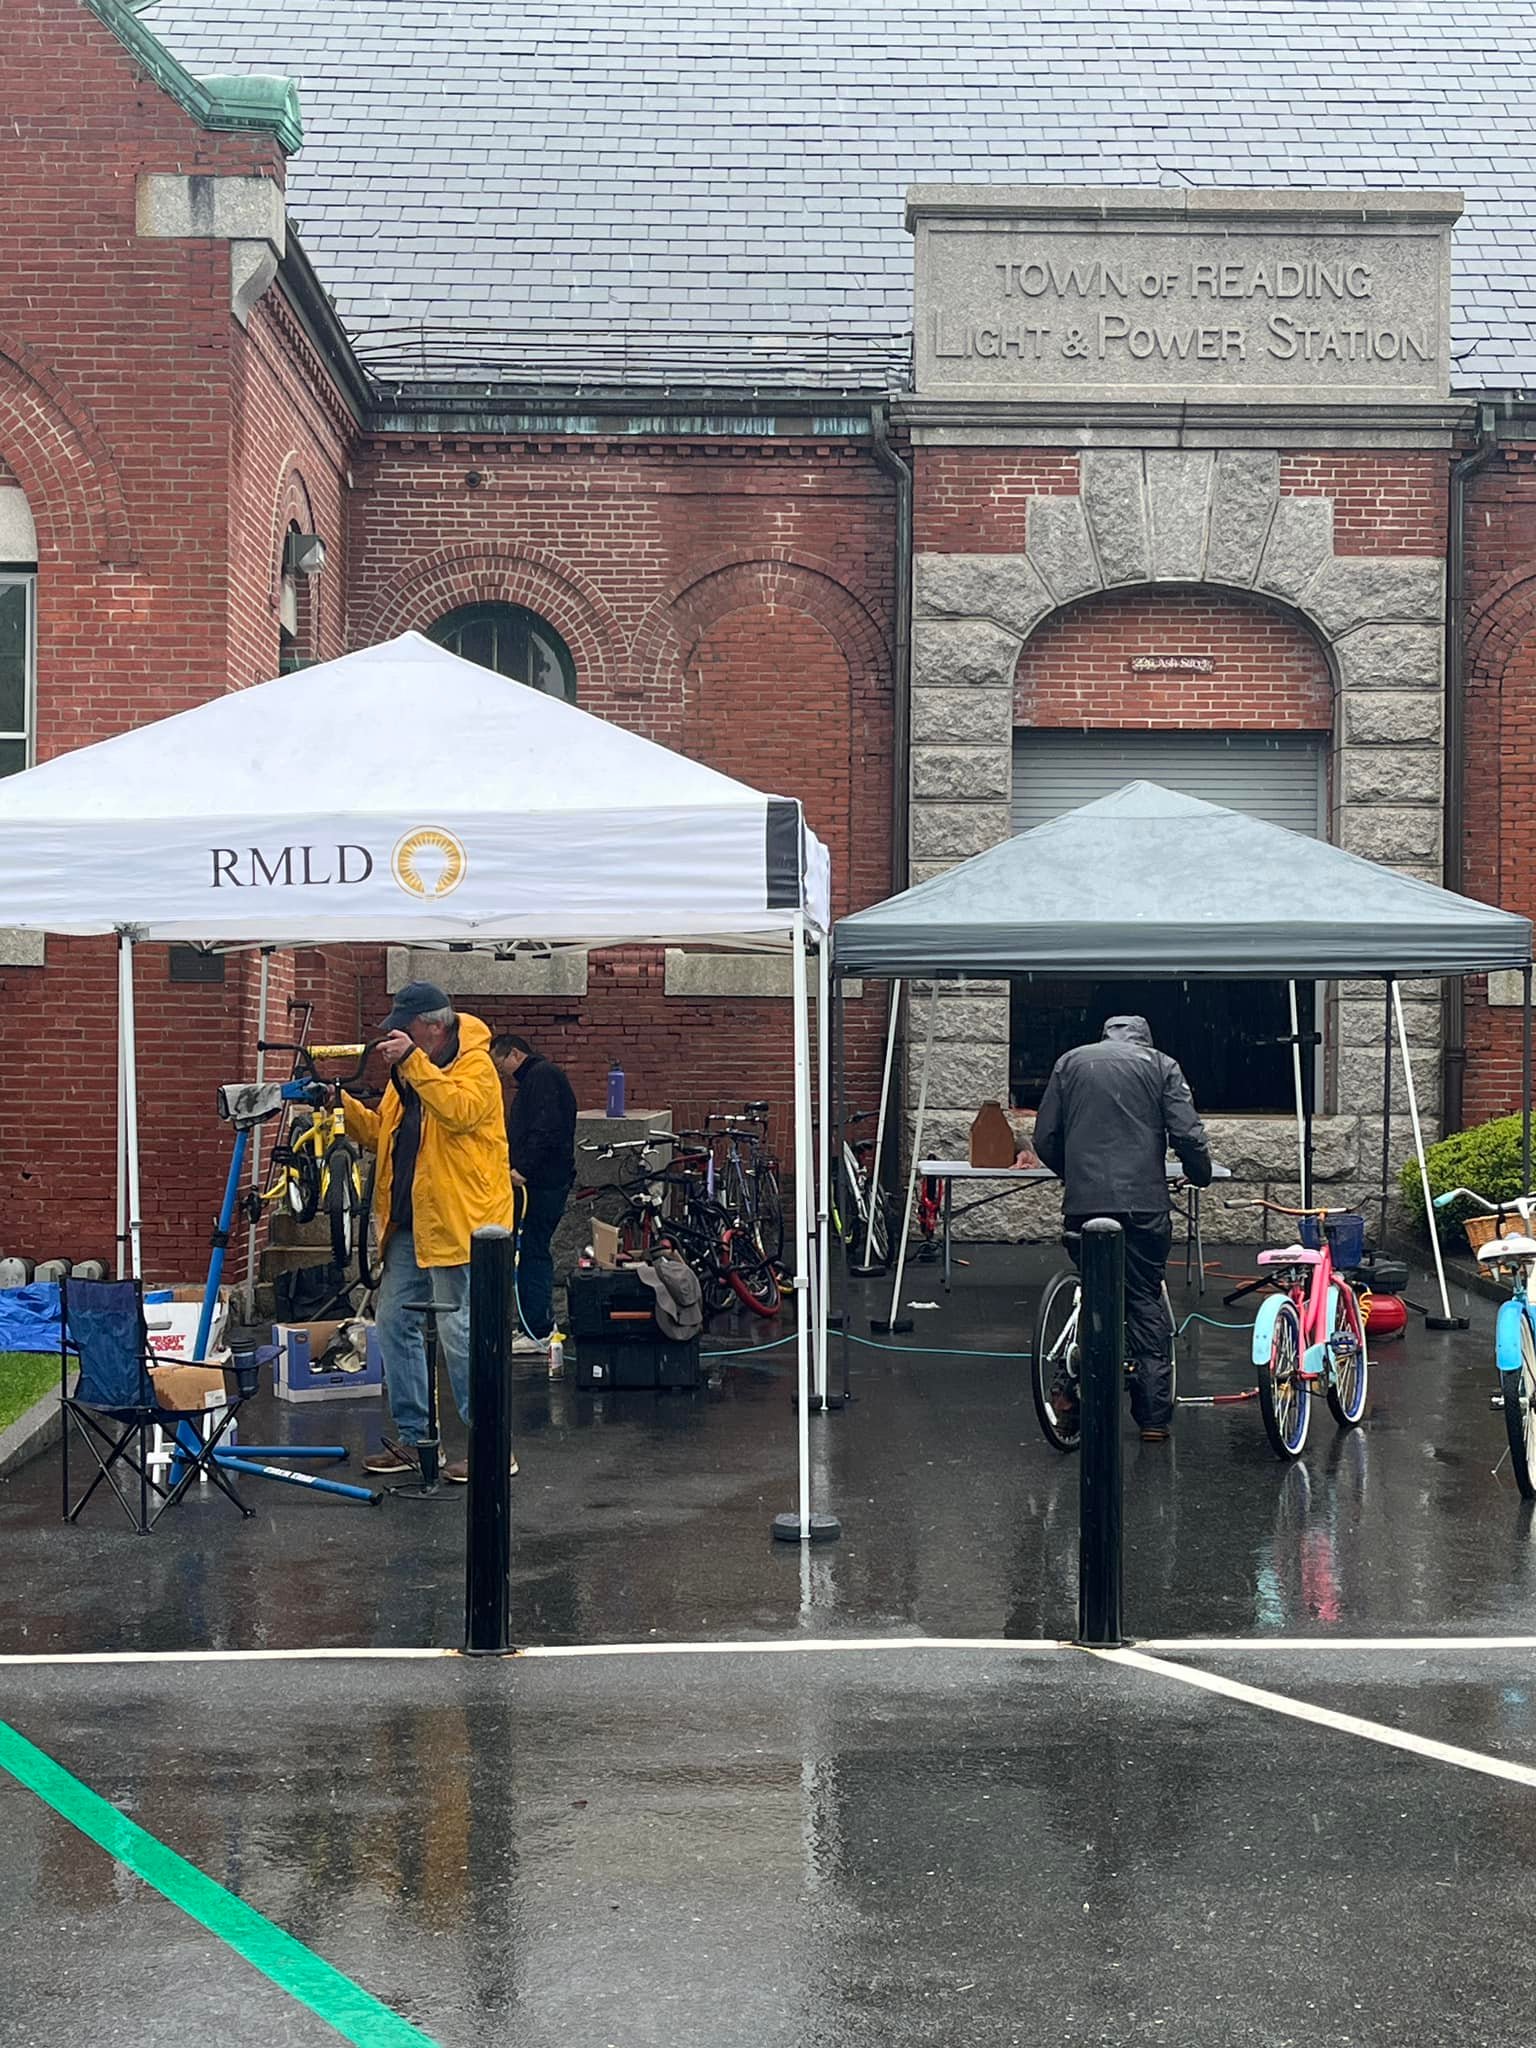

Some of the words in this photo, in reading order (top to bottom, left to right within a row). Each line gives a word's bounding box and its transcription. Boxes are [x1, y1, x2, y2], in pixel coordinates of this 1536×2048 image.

[996, 261, 1128, 298] TOWN
[1140, 273, 1178, 298] OF
[1191, 261, 1373, 299] READING
[1062, 326, 1091, 359] &
[208, 844, 374, 888] RMLD
